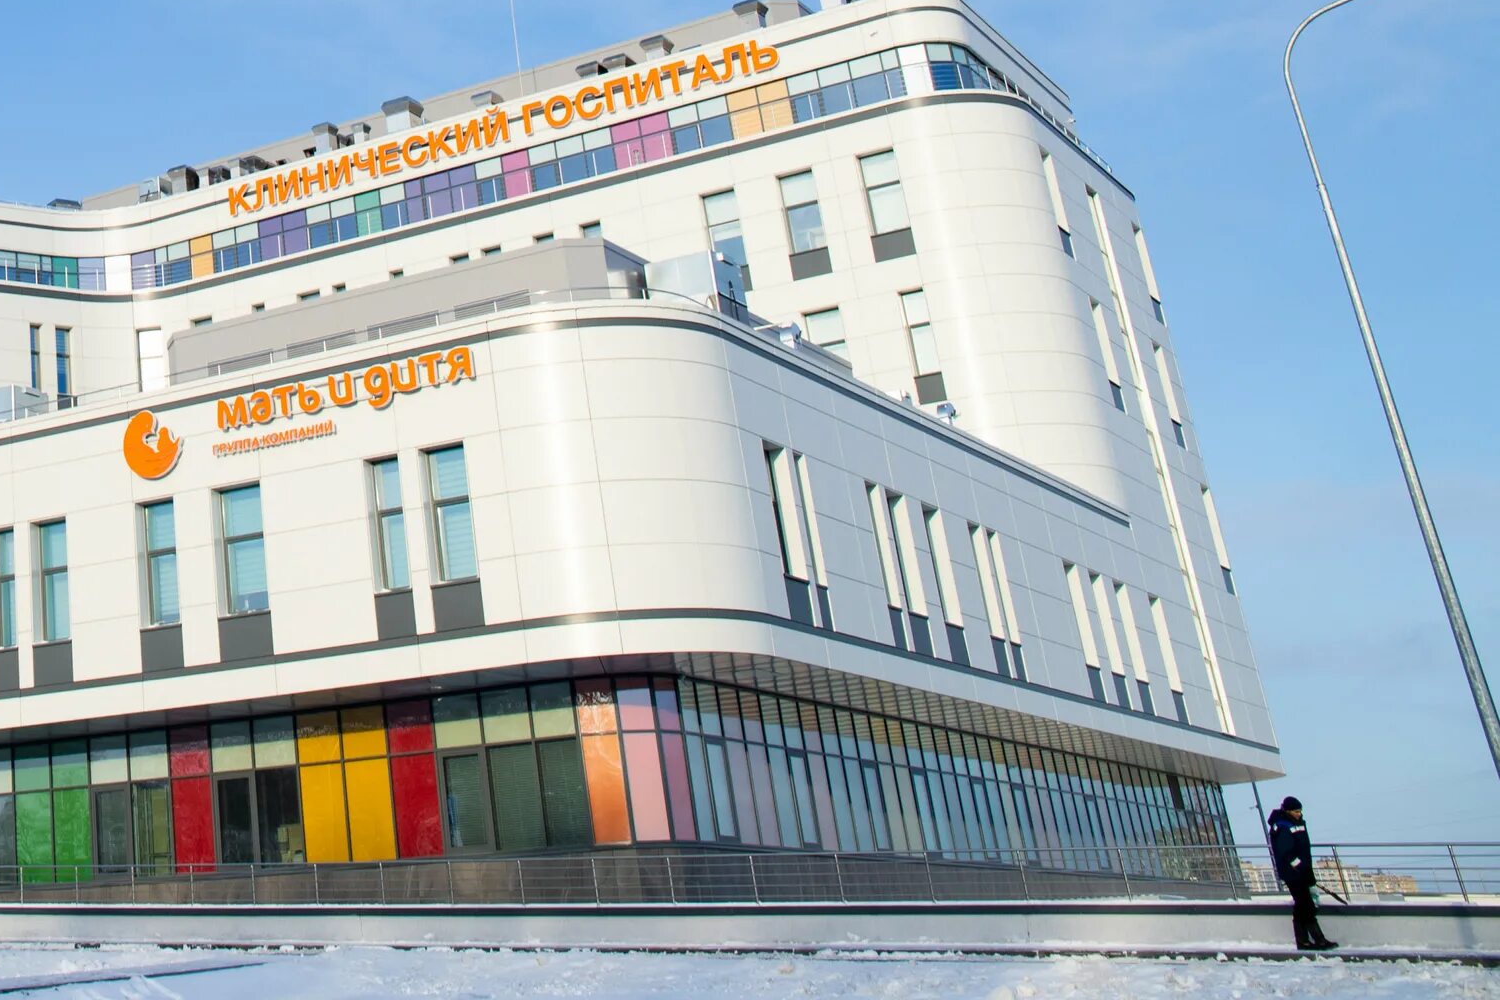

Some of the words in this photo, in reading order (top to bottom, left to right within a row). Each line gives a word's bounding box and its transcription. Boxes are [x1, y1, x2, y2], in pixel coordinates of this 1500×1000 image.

[228, 107, 510, 216] КЛИНИЧЕСКИЙ
[521, 39, 780, 134] ГОСПИТАЛЬ
[211, 436, 261, 456] ГРУППА
[261, 419, 334, 446] КОМПАНИЙ
